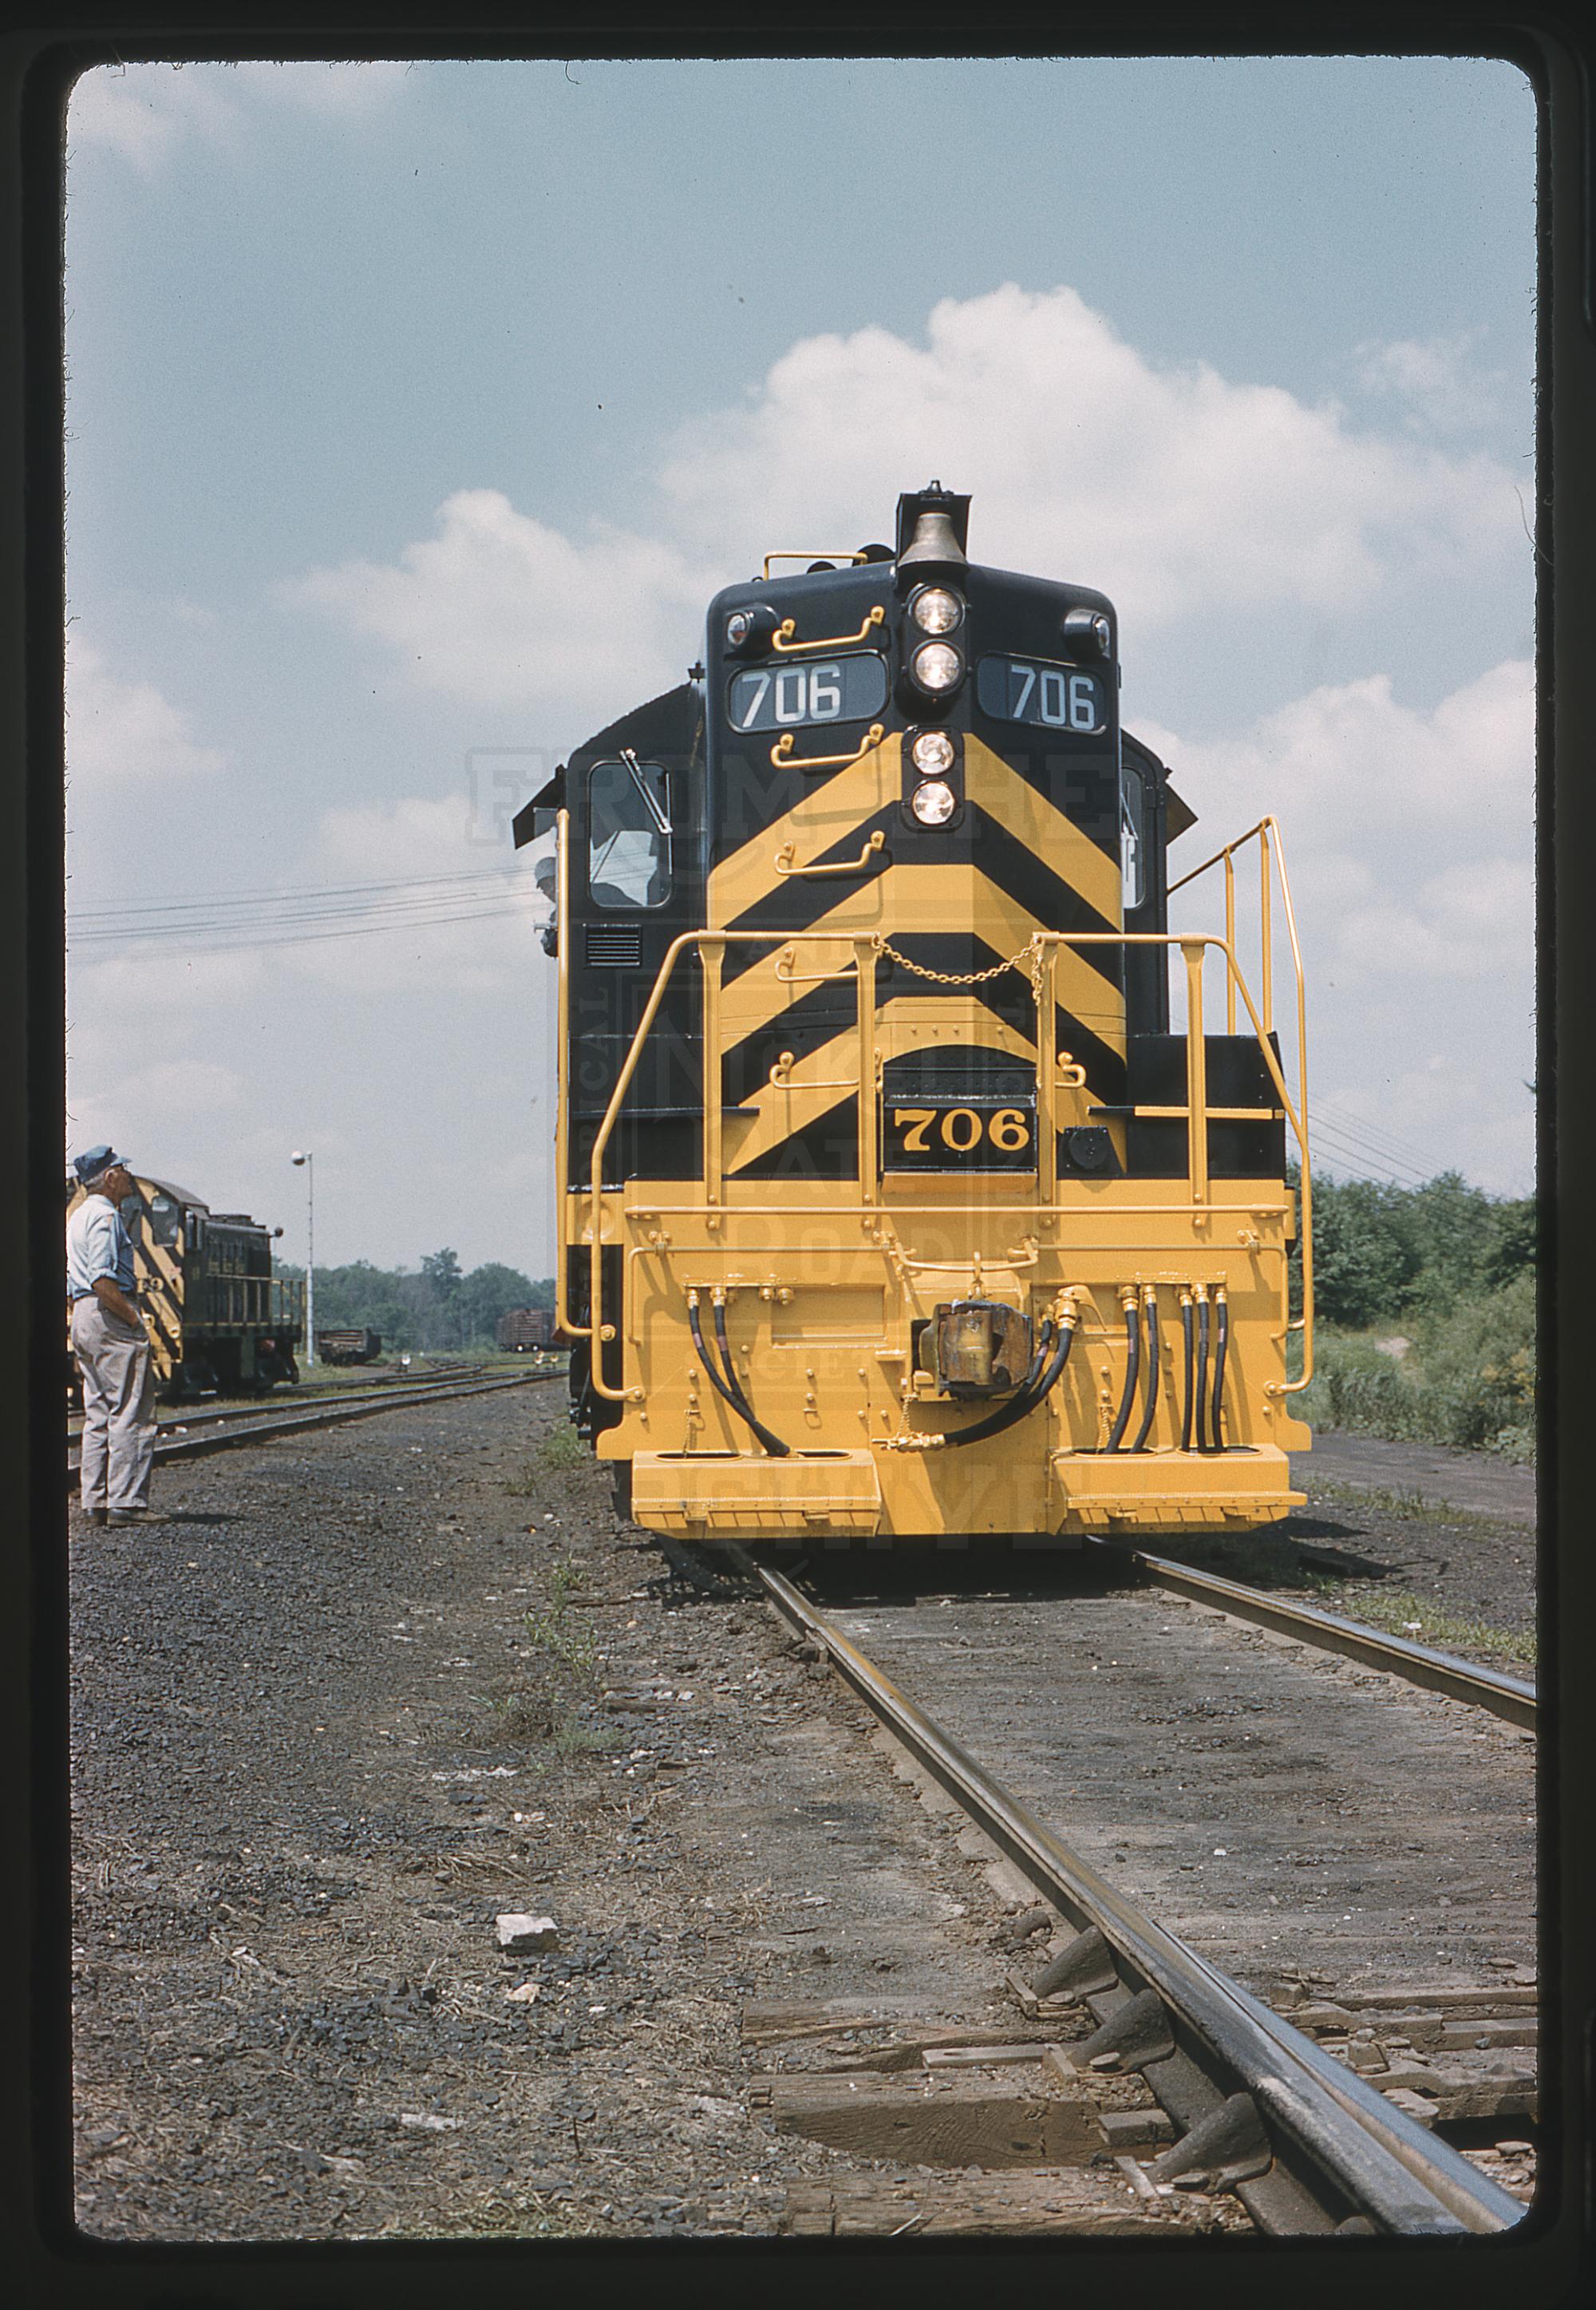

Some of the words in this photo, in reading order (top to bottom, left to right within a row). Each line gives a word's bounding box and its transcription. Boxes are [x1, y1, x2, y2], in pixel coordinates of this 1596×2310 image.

[741, 664, 841, 728] 706
[1010, 664, 1096, 730] 706
[894, 1107, 1030, 1152] 706
